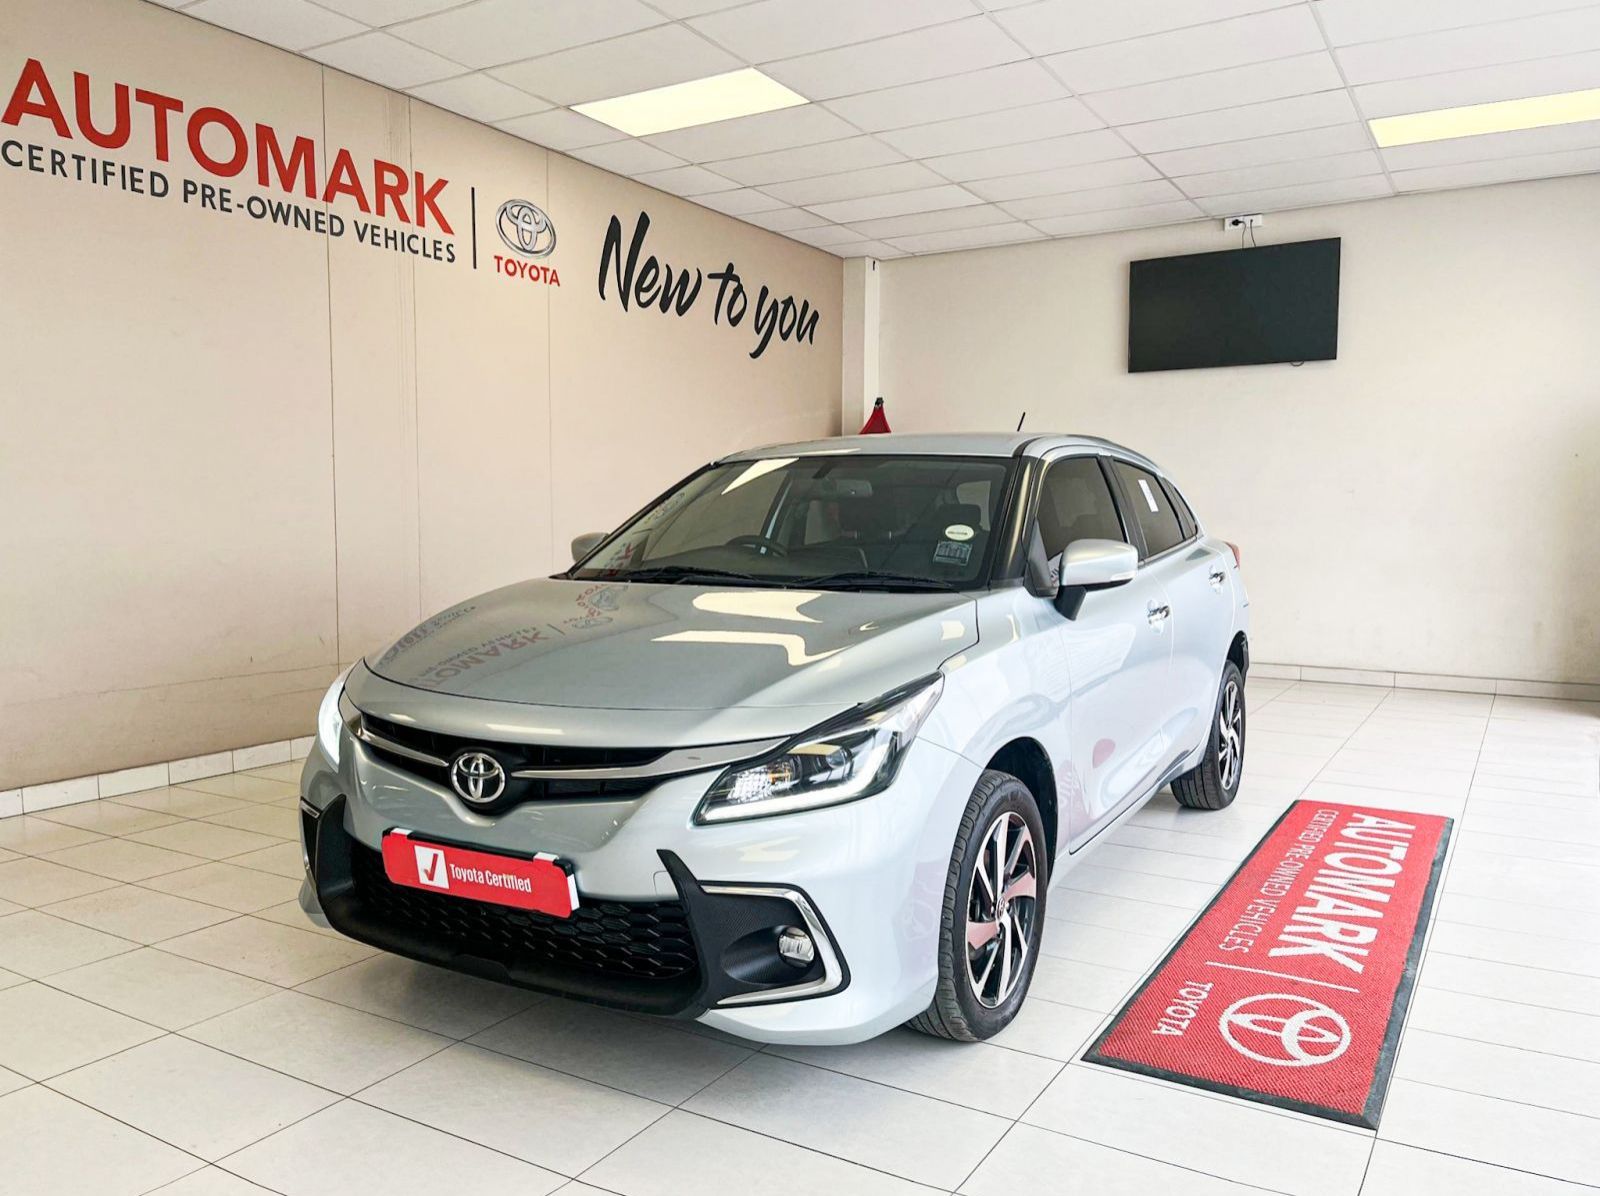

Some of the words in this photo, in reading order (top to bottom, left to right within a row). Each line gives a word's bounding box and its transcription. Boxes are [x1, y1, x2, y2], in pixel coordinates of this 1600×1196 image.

[1, 58, 455, 236] AUTOMARK
[1, 140, 169, 198] CERTIFIED
[183, 179, 345, 237] PRE-OWNED
[354, 220, 456, 264] VEHICLES
[494, 255, 560, 287] TOYOTA
[598, 211, 702, 316] New
[707, 262, 748, 327] to
[749, 285, 820, 359] you
[1298, 809, 1340, 842] CERTIFIED
[450, 863, 485, 884] Toyota
[485, 869, 532, 893] Certified
[1260, 842, 1316, 897] PRE-OWNED
[1268, 812, 1416, 974] AUTOMARK
[1218, 897, 1280, 953] VEHICLES
[1152, 980, 1215, 1037] TOYOTA
